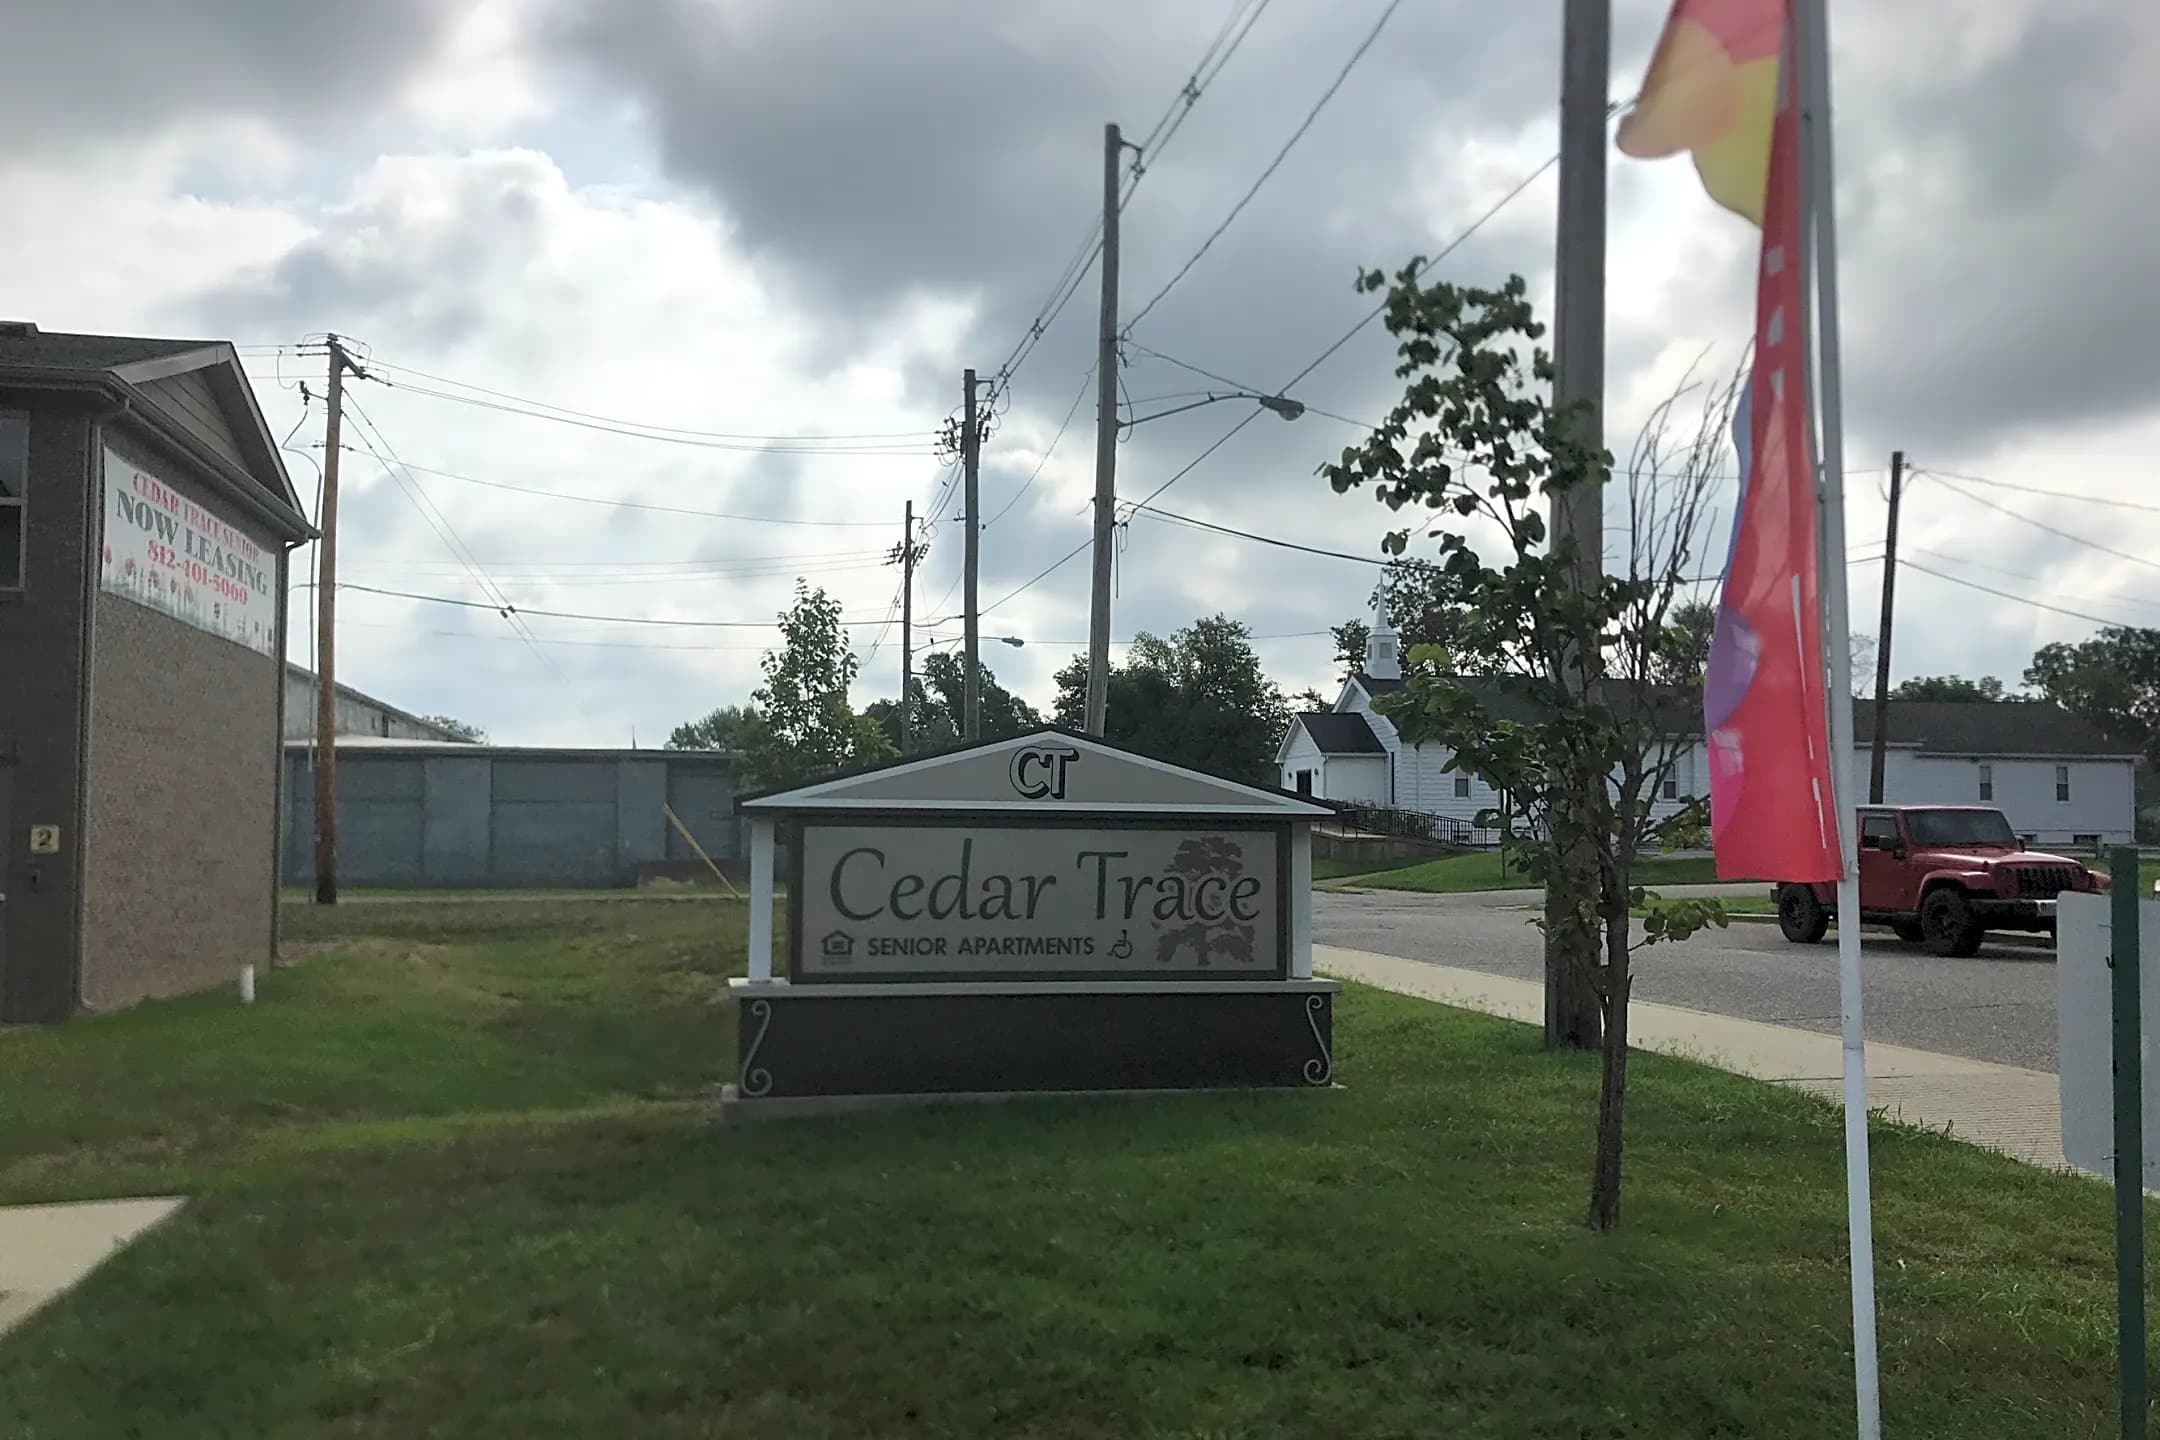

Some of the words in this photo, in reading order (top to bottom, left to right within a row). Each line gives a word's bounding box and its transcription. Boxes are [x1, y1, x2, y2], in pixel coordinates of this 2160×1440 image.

[133, 473, 179, 516] CEDAR
[117, 488, 179, 545] NOW
[185, 528, 268, 596] LEASING
[1008, 746, 1079, 799] CT
[38, 829, 53, 848] 2
[829, 838, 1057, 921] Cedar
[1076, 851, 1261, 921] Trace
[867, 936, 948, 957] SENIOR
[957, 935, 1095, 958] APARTMENTS
